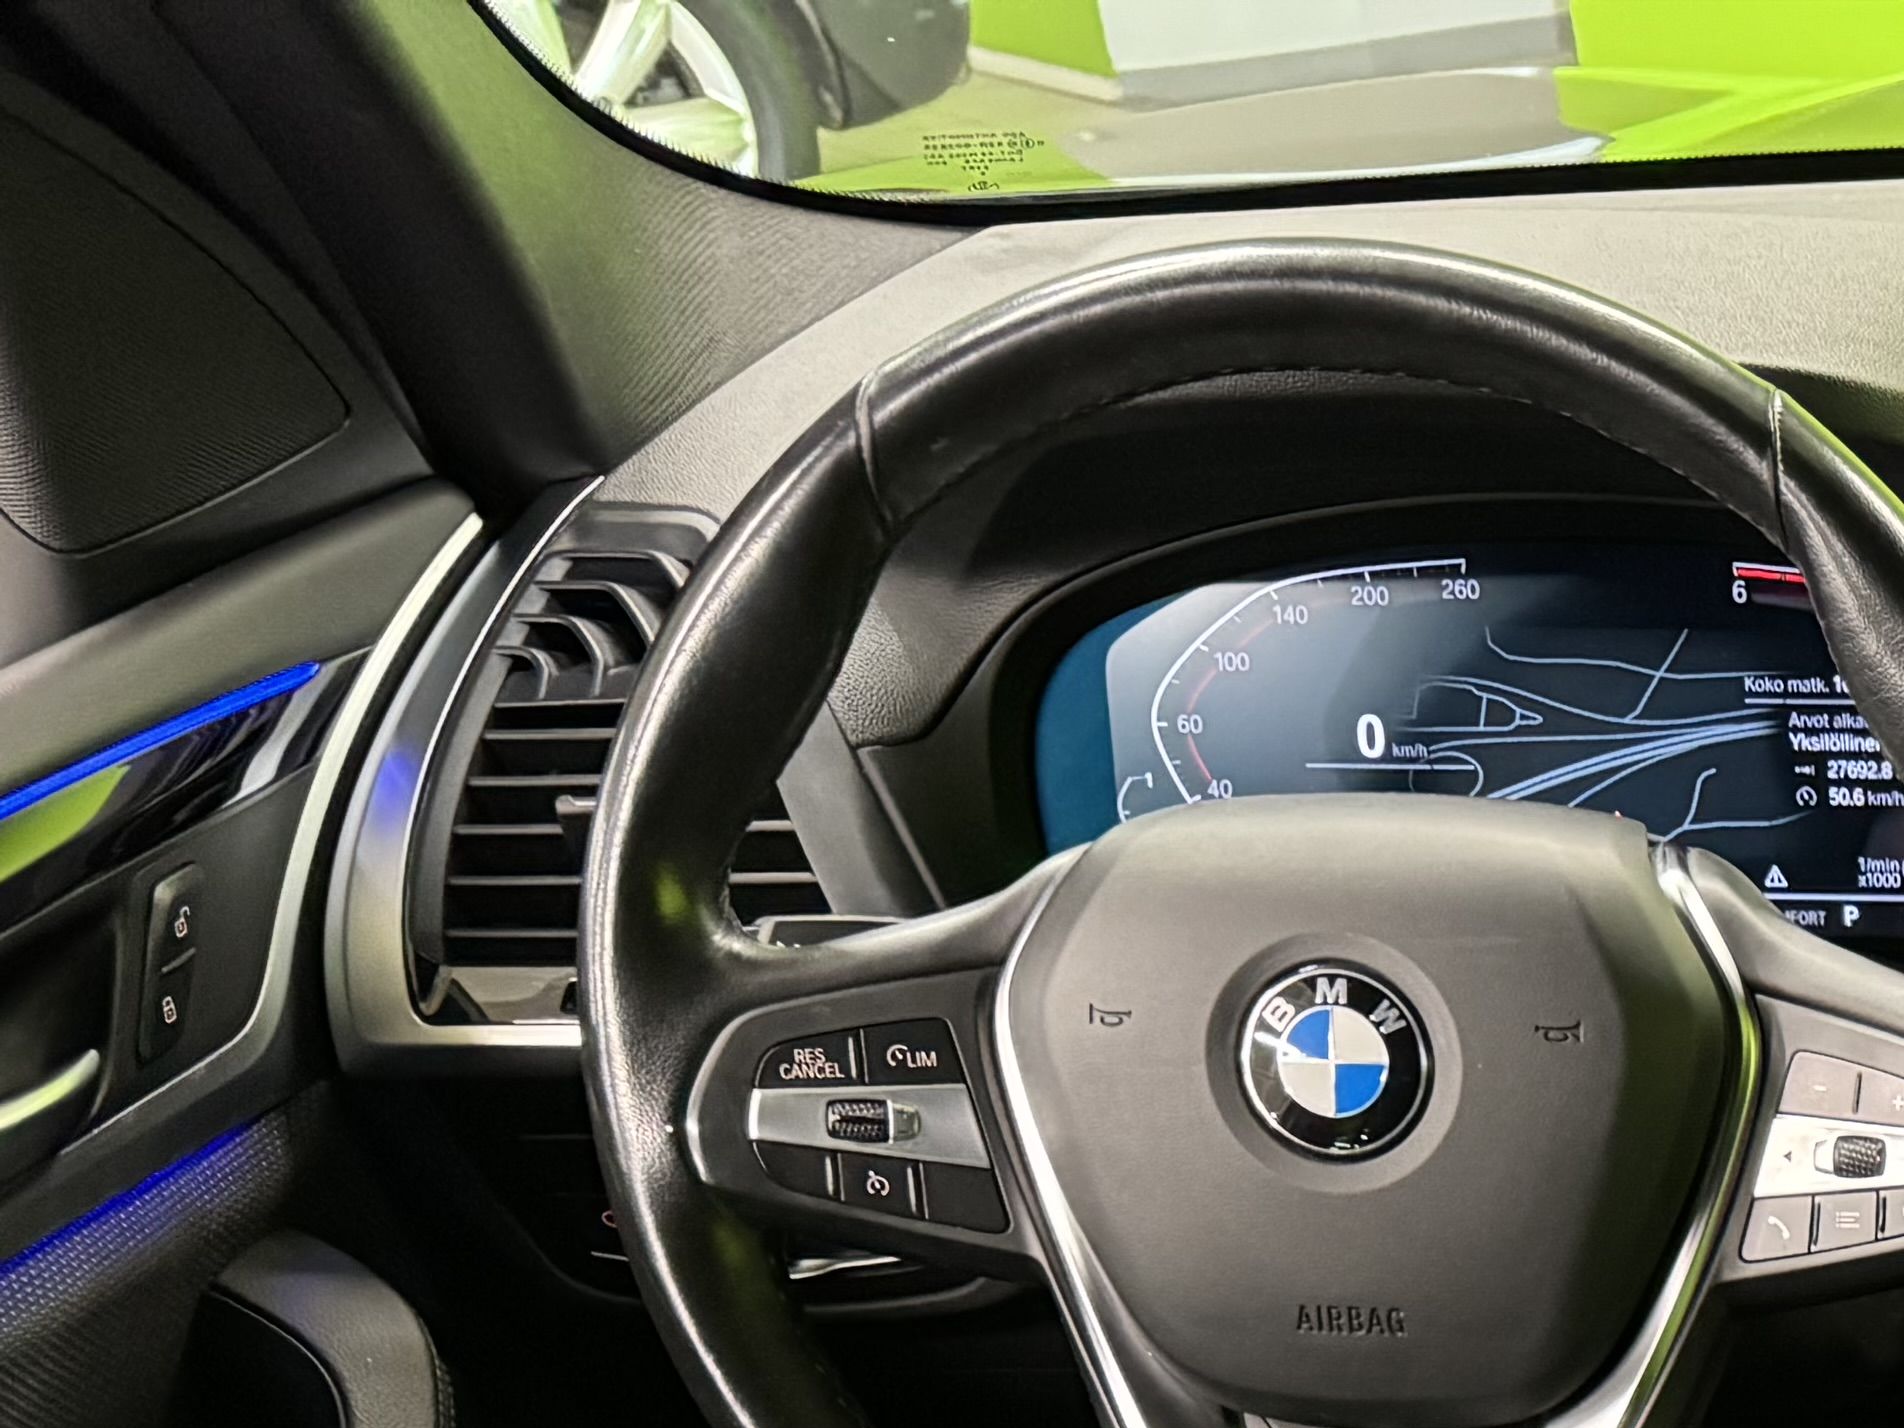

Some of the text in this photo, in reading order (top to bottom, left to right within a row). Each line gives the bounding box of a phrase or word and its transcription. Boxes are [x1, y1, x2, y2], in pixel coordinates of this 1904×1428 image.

[1351, 585, 1390, 606] 200
[1441, 578, 1480, 600] 260
[1731, 579, 1748, 604] 6
[1272, 604, 1309, 625] 140
[1214, 652, 1250, 672] 100
[1744, 676, 1784, 693] Koko
[1177, 714, 1203, 734] 60
[1788, 711, 1830, 729] Arvot
[1356, 713, 1429, 759] 0 km/h
[1826, 759, 1893, 780] 27692.8
[1207, 780, 1233, 799] 40
[1828, 786, 1904, 807] 50.6 km/h
[1857, 856, 1900, 873] 1/min
[1857, 872, 1901, 889] x1000
[1843, 904, 1860, 928] P
[1261, 976, 1407, 1034] BMW
[793, 1047, 827, 1065] RES
[906, 1050, 938, 1068] LIM
[779, 1062, 845, 1080] CANCEL
[1295, 1304, 1406, 1336] AIRBAG
